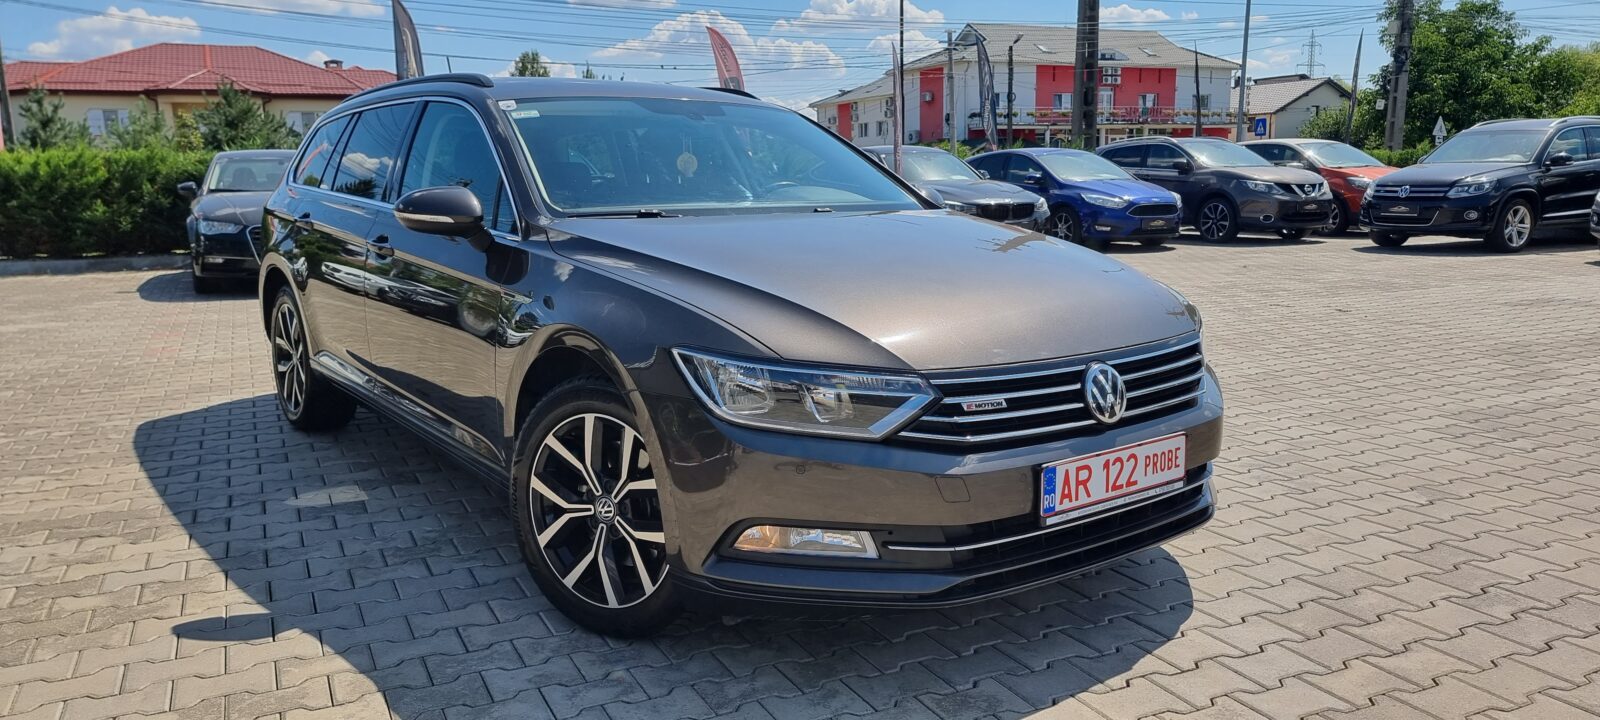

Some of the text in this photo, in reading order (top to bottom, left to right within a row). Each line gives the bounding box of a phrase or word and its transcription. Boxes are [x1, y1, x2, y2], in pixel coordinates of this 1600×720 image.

[1059, 447, 1181, 505] AR 122 PROBE
[1044, 493, 1055, 509] RO
